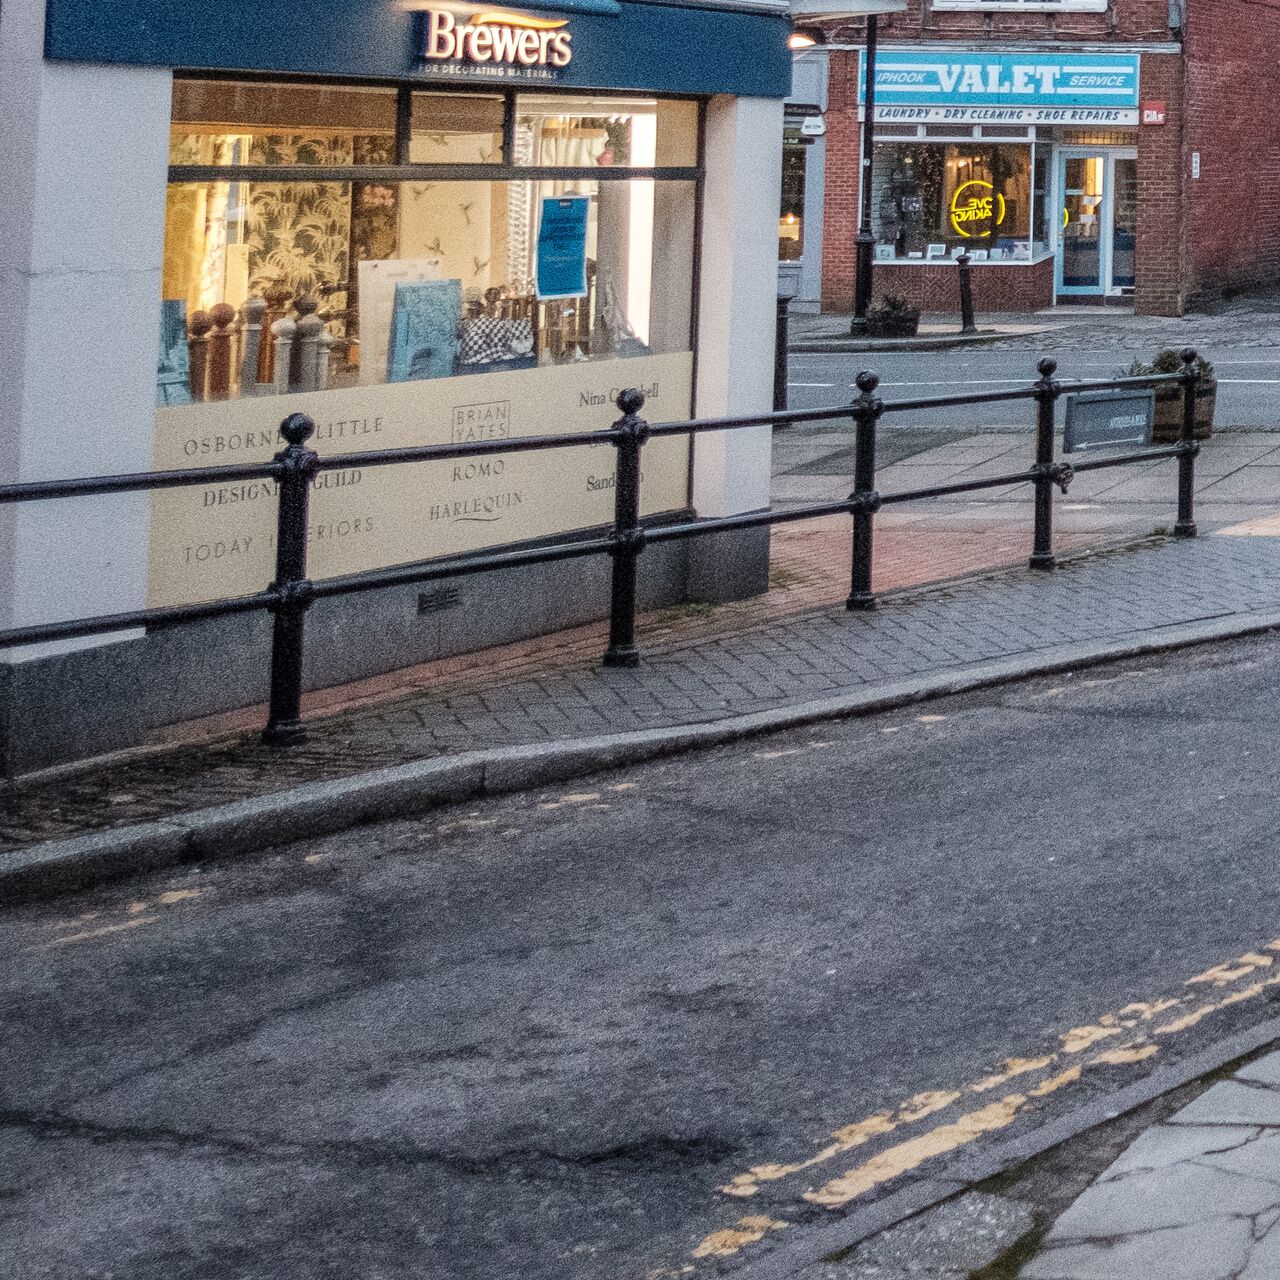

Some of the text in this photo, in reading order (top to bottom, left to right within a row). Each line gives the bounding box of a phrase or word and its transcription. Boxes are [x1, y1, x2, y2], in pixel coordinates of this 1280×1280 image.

[426, 9, 573, 67] Brewers
[442, 64, 504, 77] DECORATING
[507, 67, 558, 80] MATERIALS
[877, 64, 1126, 94] IPHOOK VALET SERVICE
[879, 108, 1121, 121] LAUNDRY DRY CLEANING SHOE REPAIRS
[579, 391, 606, 407] Nina
[457, 406, 507, 425] BRIAN
[183, 417, 384, 456] OSBORNE LITTLE
[456, 422, 506, 441] YATES
[313, 470, 362, 490] GUILD
[452, 460, 505, 481] ROMO
[429, 491, 522, 521] HARLEQUIN
[183, 536, 254, 563] TODAY
